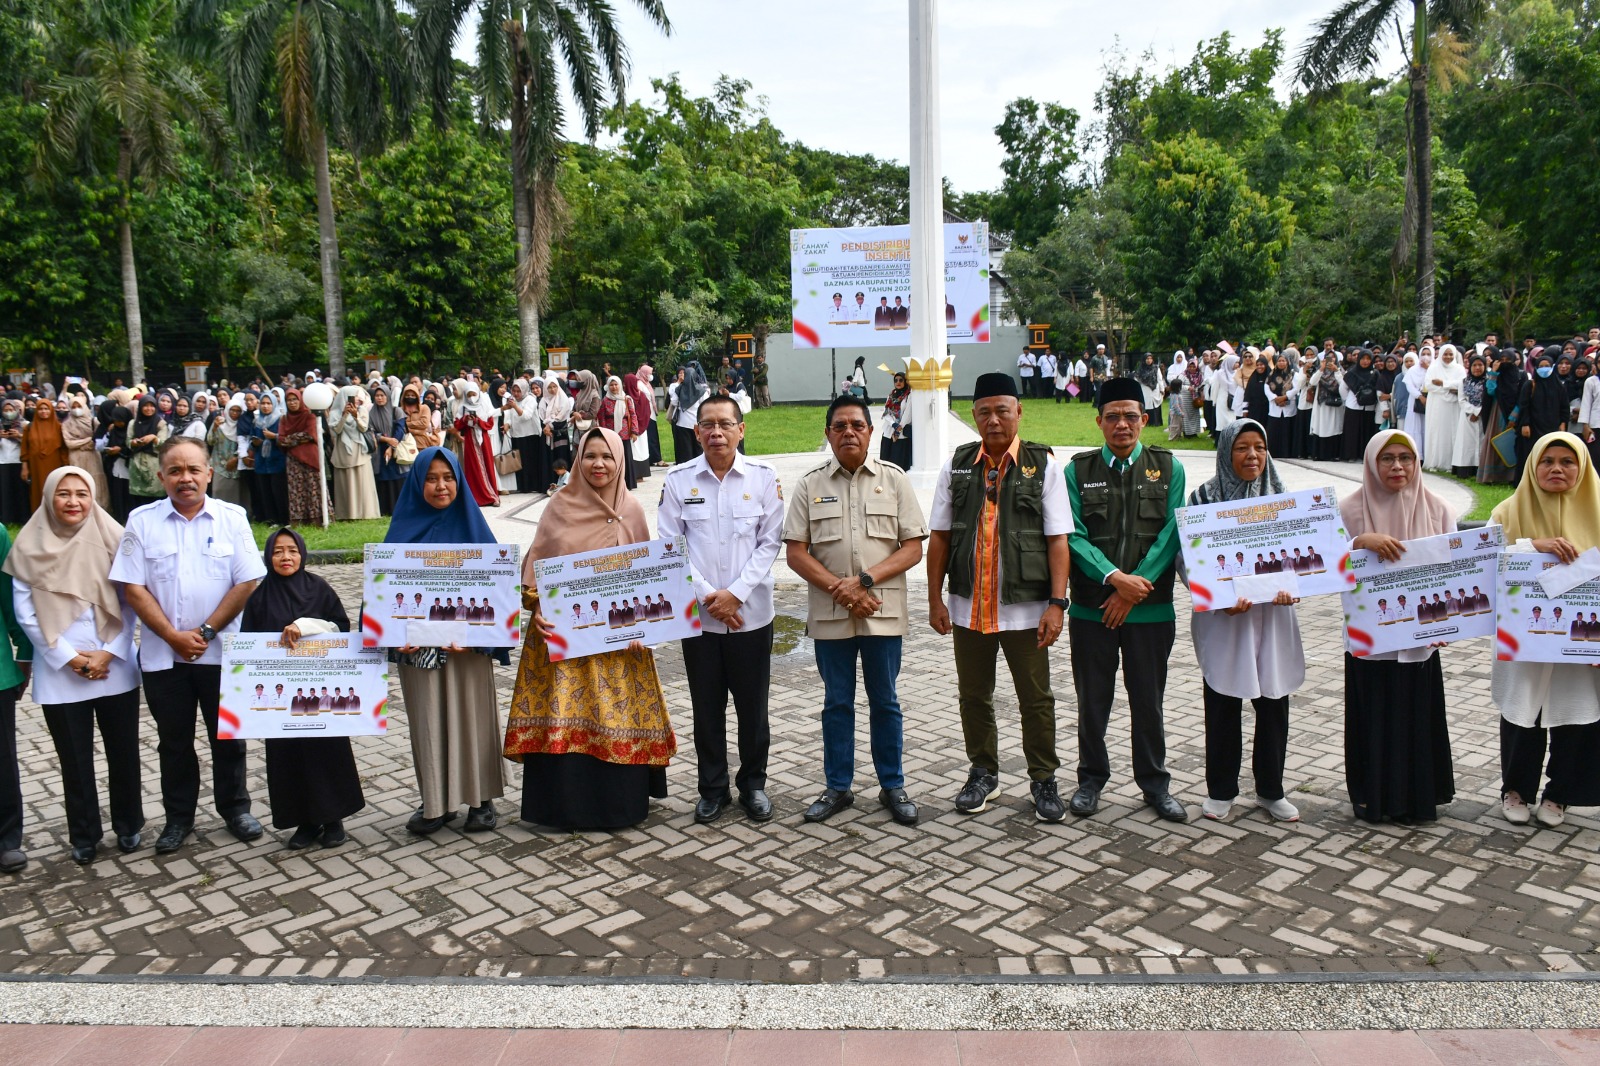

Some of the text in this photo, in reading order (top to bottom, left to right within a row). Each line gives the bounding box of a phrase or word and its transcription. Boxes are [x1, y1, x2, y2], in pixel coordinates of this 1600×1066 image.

[841, 239, 910, 252] PENDISTRIBU
[1216, 498, 1296, 519] PENDISTRIBUSIAN
[1238, 512, 1278, 525] INSENTIF
[1234, 537, 1269, 545] KABUPATEN
[404, 549, 482, 559] PENDISTRIBUSIAN
[573, 546, 649, 569] PENDISTRIBUSIAN
[423, 559, 464, 568] INSENTIF
[593, 561, 632, 574] INSENTIF
[1396, 578, 1433, 588] KABUPATEN
[1435, 572, 1462, 581] LOMBOK
[564, 589, 587, 598] BAZNAS
[589, 584, 623, 593] KABUPATEN
[266, 639, 348, 648] PEDSTRIBUSIAN
[286, 650, 329, 658] INSENTIF
